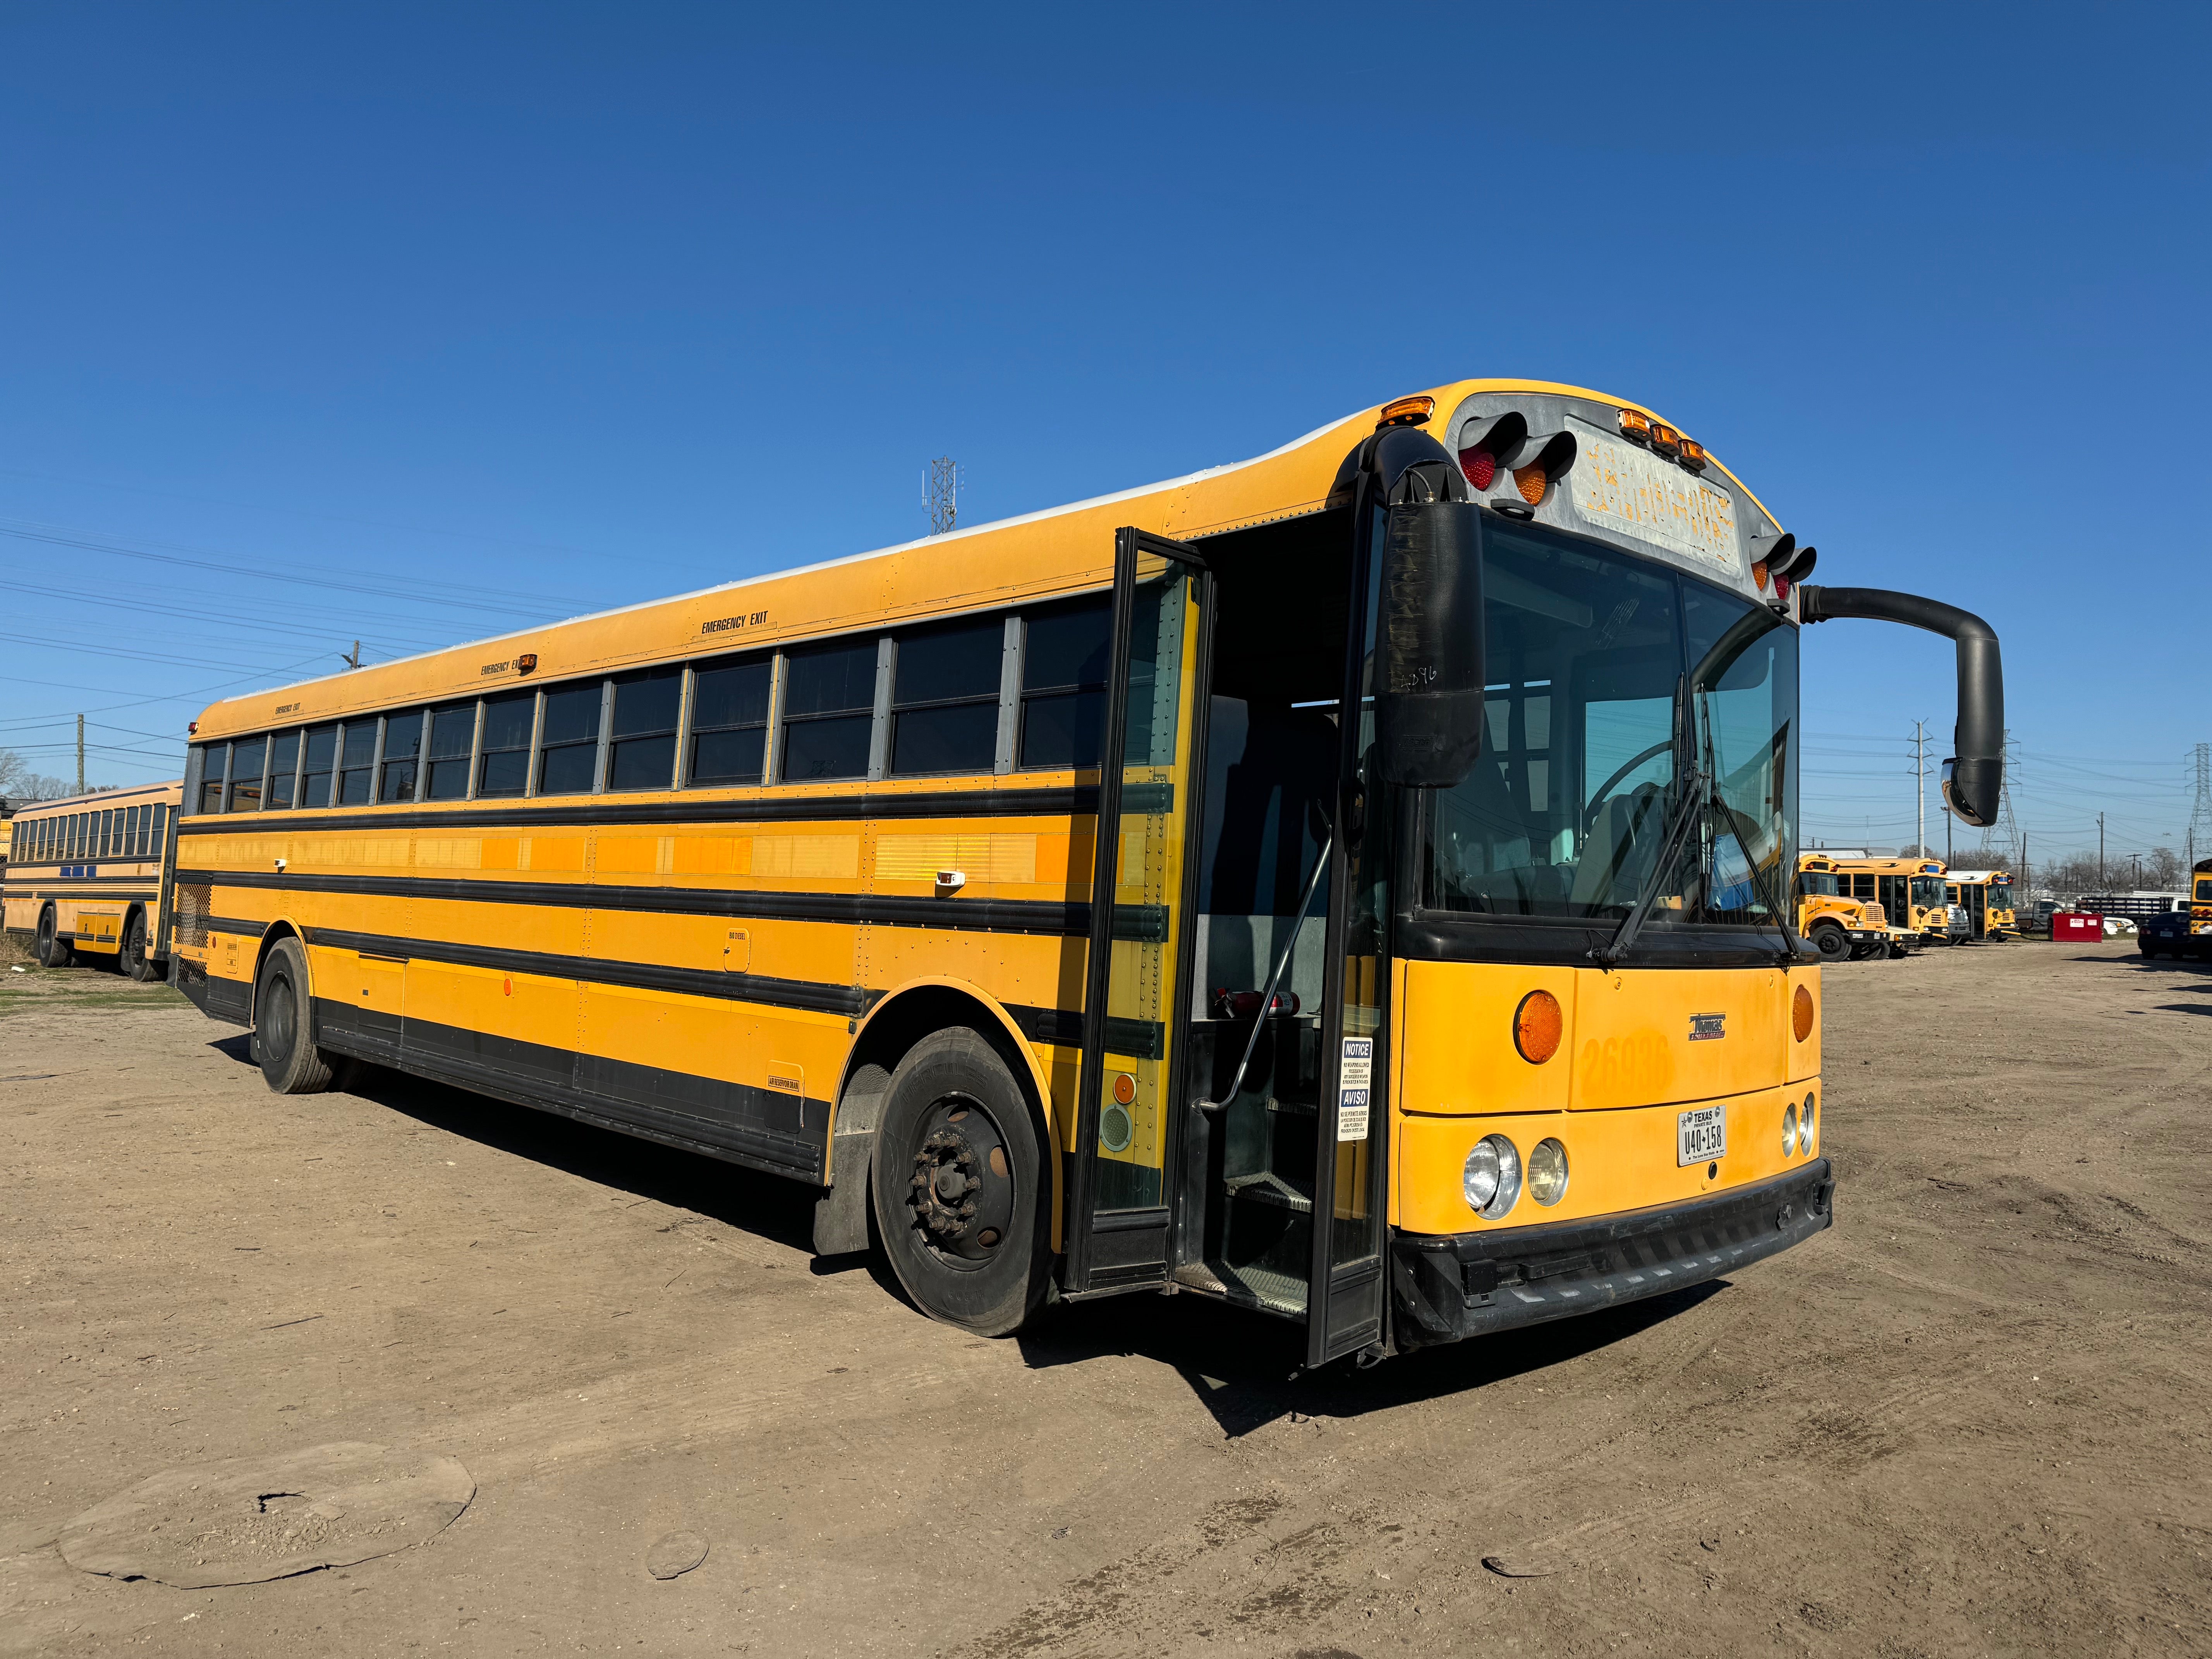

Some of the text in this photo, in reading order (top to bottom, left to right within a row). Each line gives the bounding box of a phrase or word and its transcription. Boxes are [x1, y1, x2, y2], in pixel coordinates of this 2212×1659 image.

[702, 610, 768, 634] EMERGENCY EXIT
[481, 661, 510, 675] EMERGENCY
[1345, 1043, 1369, 1056] NOTICE
[1343, 1091, 1366, 1105] AVISO
[1694, 1110, 1712, 1123] TEXAS
